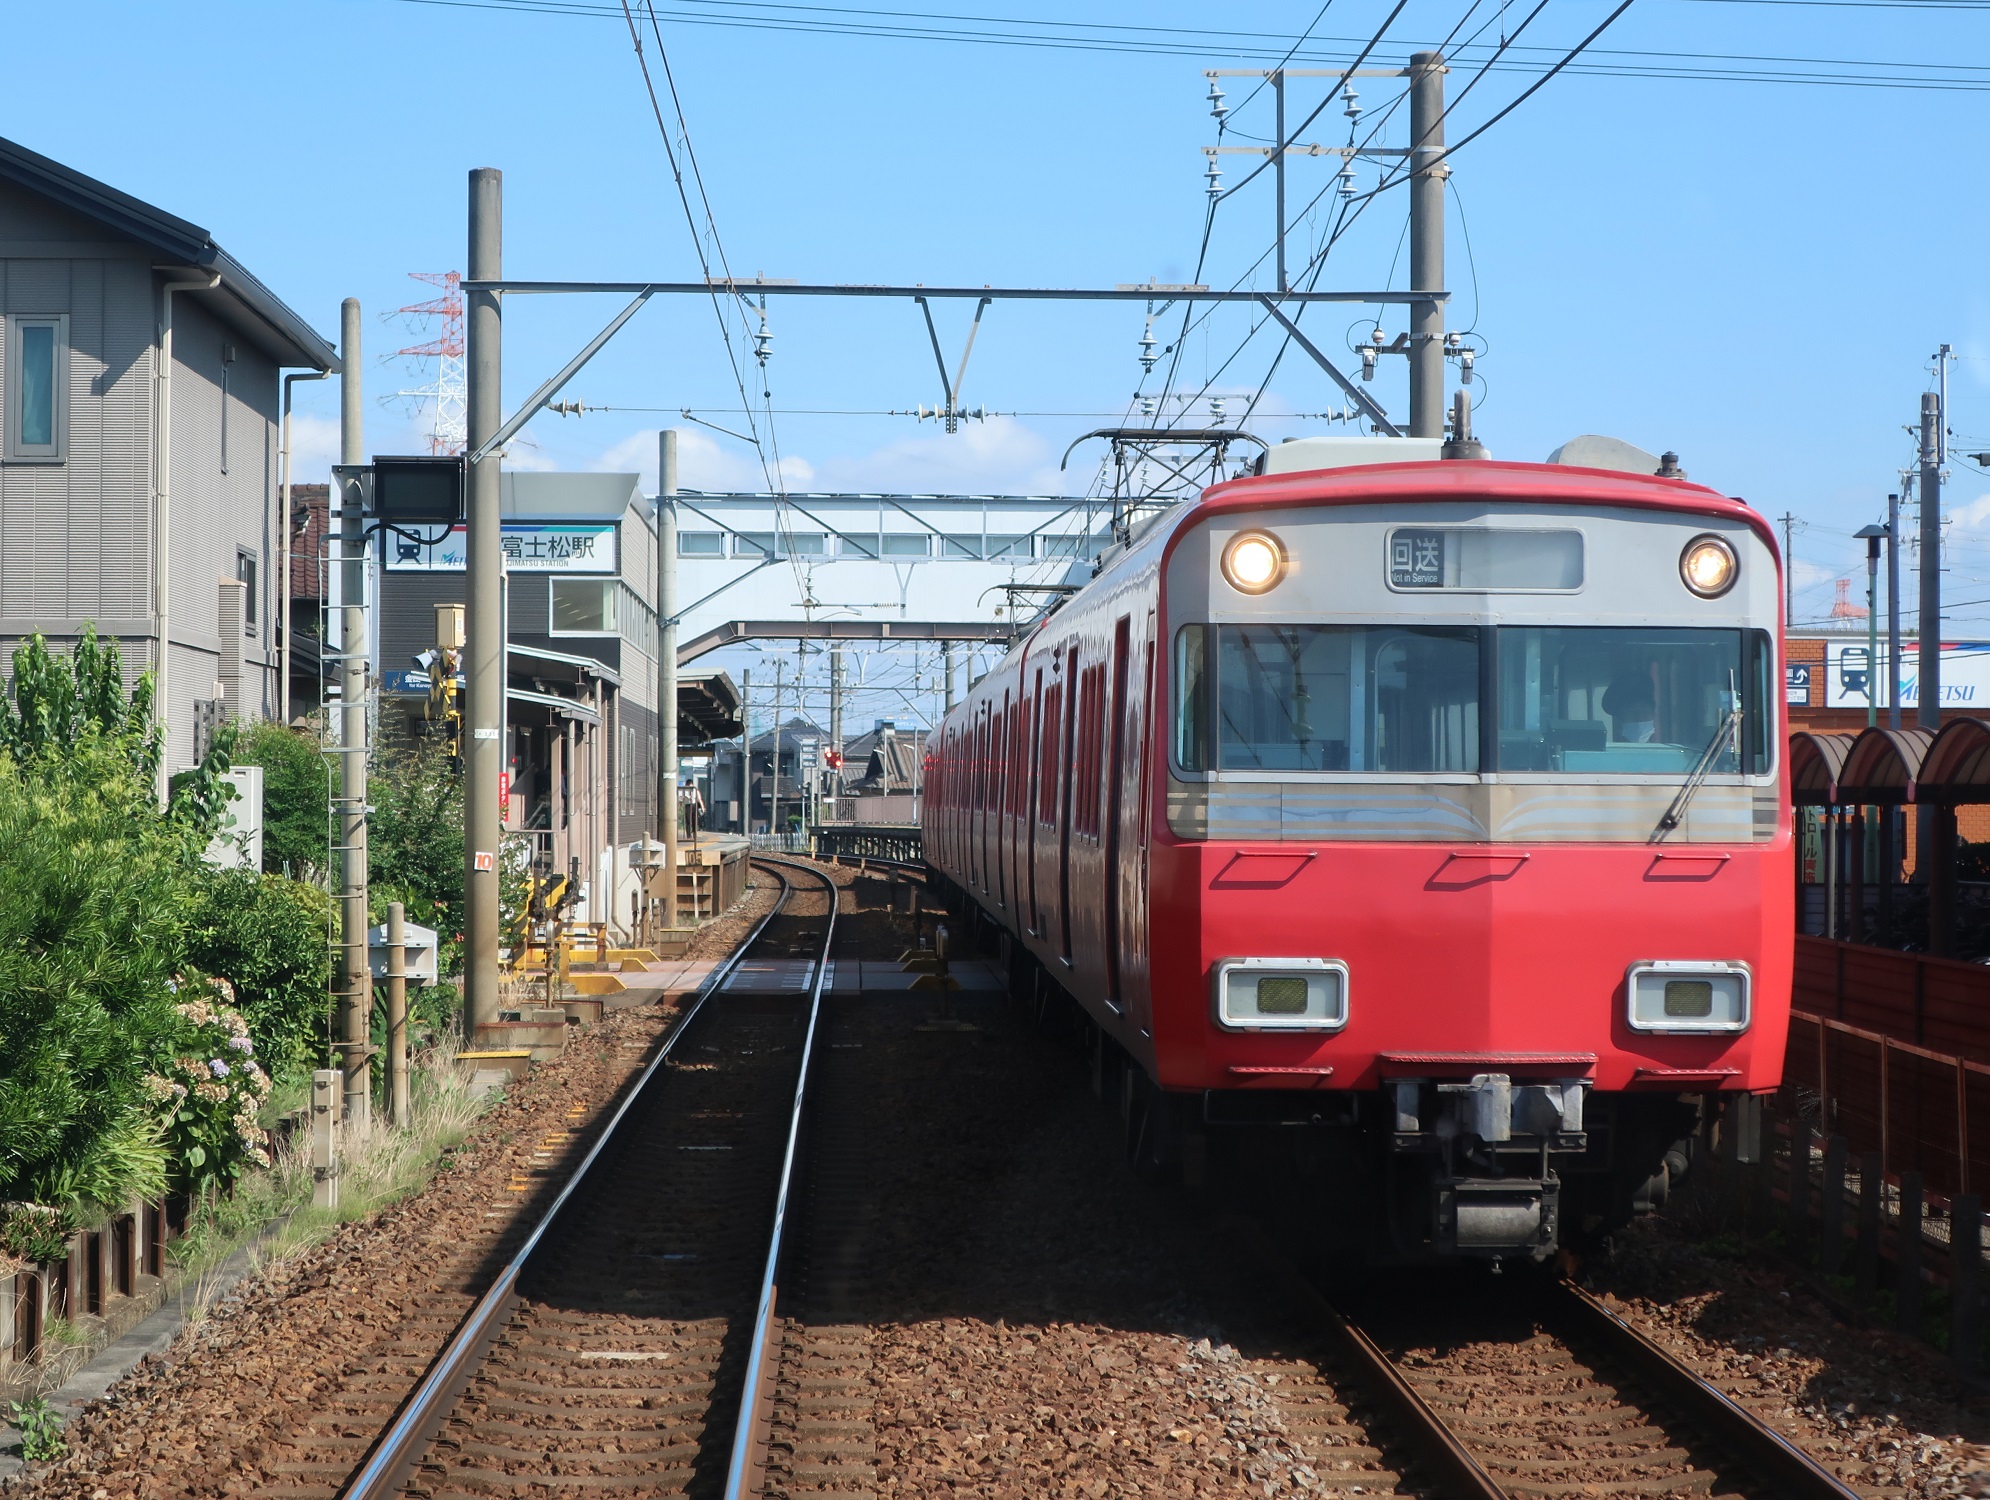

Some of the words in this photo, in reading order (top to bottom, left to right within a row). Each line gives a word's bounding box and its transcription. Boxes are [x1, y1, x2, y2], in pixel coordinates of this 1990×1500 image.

[501, 535, 595, 559] 富士松駅
[1391, 537, 1439, 572] 回送
[541, 559, 569, 567] STATION
[1391, 572, 1403, 583] Not
[1404, 573, 1411, 583] in
[1412, 572, 1438, 583] Service
[475, 854, 492, 870] 10
